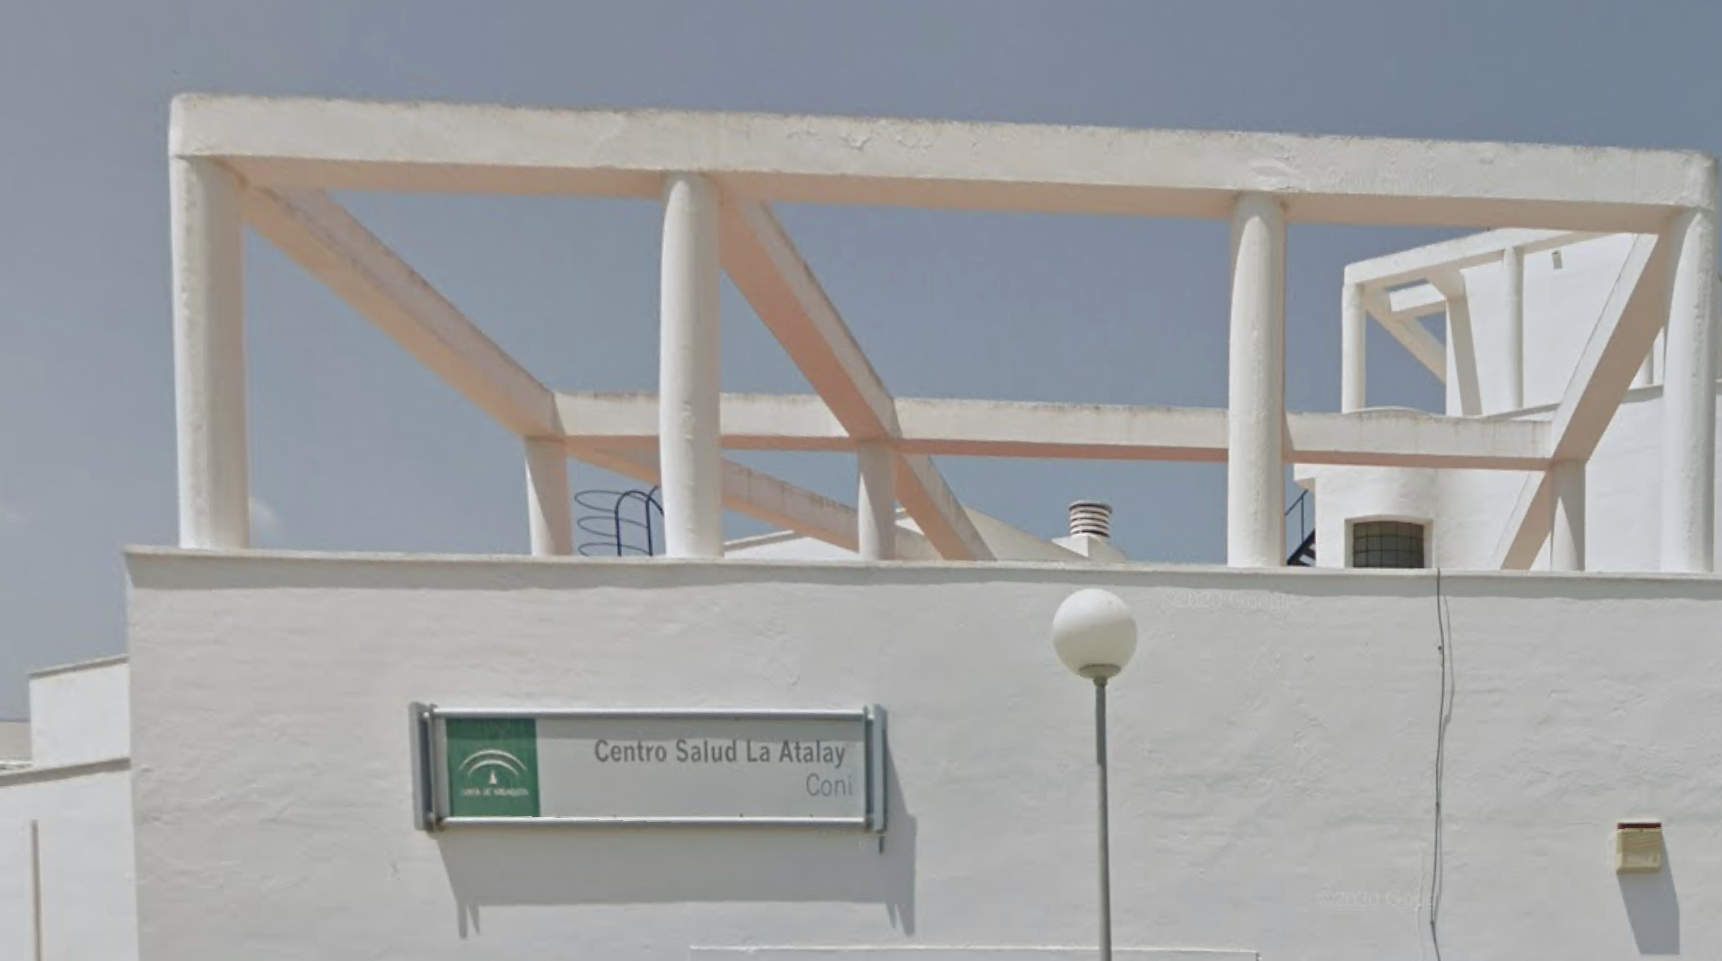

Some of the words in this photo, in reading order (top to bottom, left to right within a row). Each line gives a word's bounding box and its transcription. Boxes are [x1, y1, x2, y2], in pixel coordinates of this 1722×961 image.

[593, 738, 667, 763] Centro
[676, 739, 738, 763] Salud
[746, 740, 770, 763] La
[779, 740, 846, 769] Atalay
